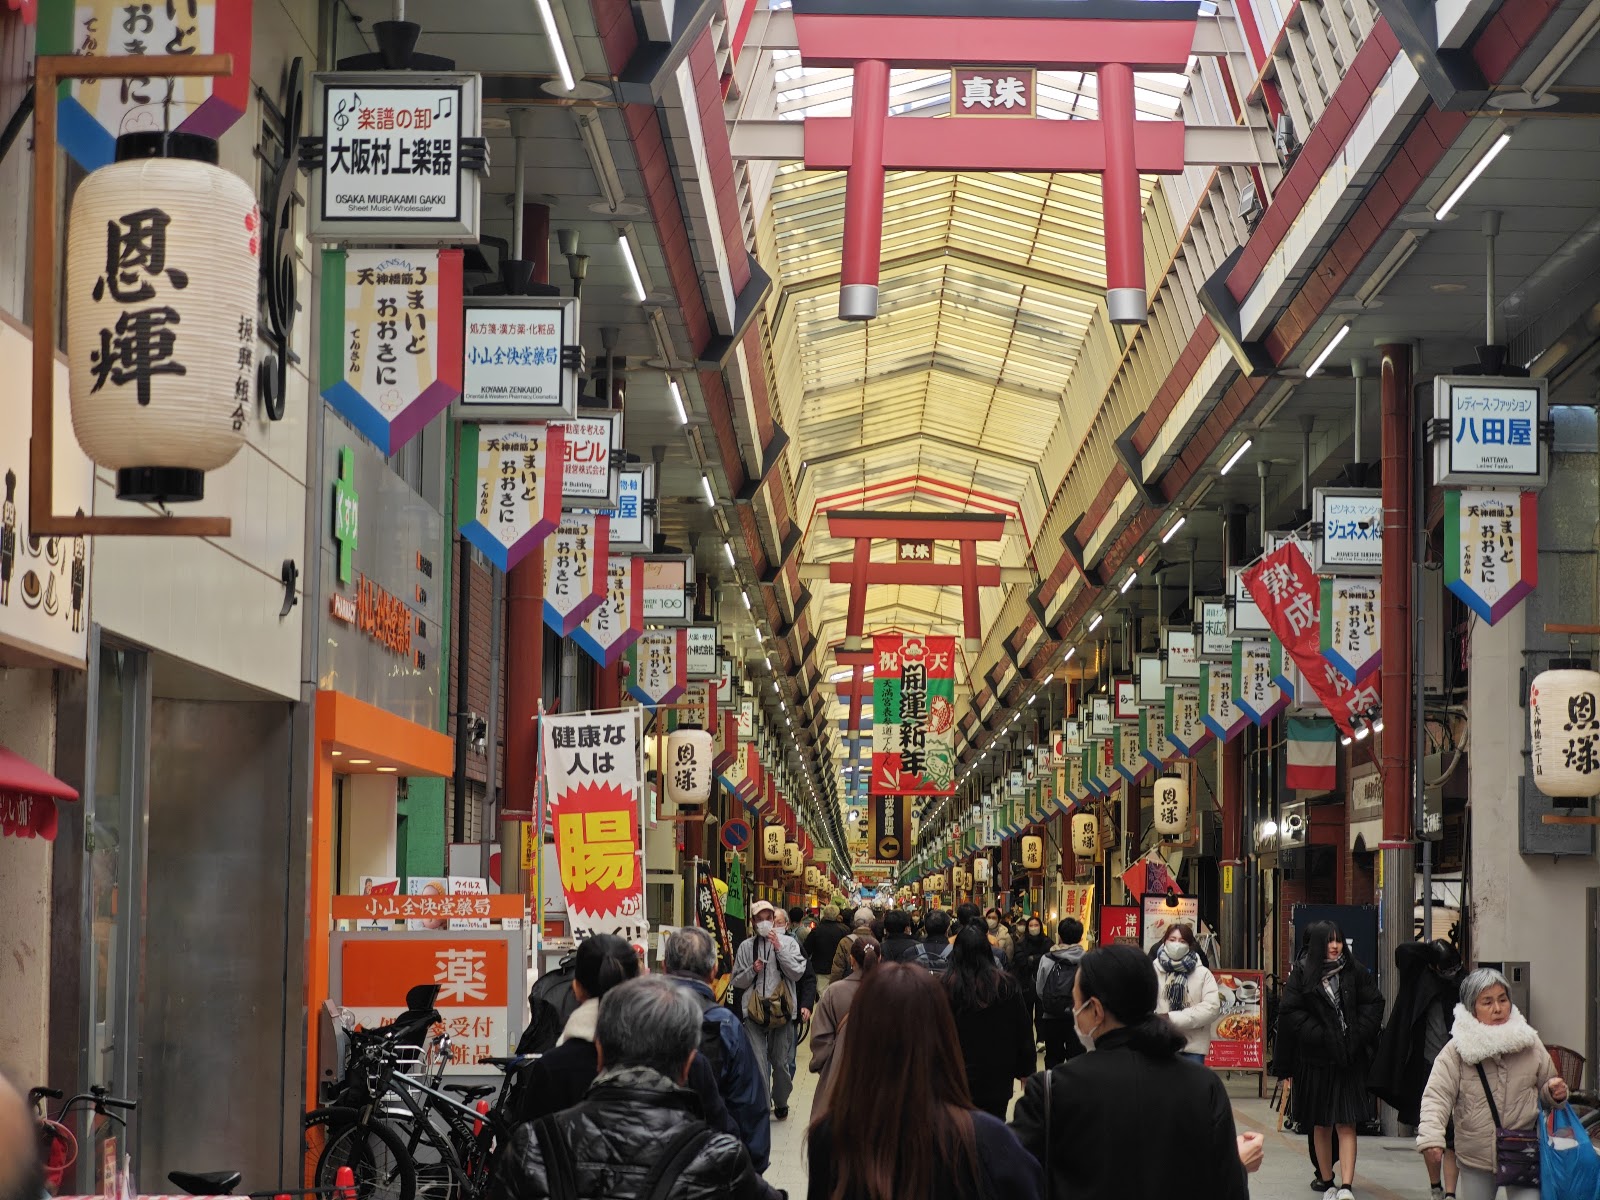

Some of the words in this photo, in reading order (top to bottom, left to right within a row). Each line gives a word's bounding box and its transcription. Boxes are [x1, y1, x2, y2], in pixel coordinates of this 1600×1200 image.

[961, 76, 1027, 109] 真朱
[357, 107, 432, 130] 楽譜の卸
[330, 137, 453, 176] 大阪村上楽器
[335, 194, 365, 204] OSAKA
[367, 194, 417, 205] MURAKAMI
[419, 195, 446, 205] GAKKI
[348, 204, 369, 212] Sheet
[371, 204, 392, 212] Music
[394, 204, 433, 213] Wholesaler
[376, 258, 415, 272] TENSAN
[376, 297, 398, 386] おおきに
[405, 290, 427, 355] まいど
[350, 328, 361, 373] てんさん
[230, 315, 254, 432] 振興組合
[481, 386, 507, 394] KOYAMA
[1457, 397, 1532, 412] レディース・ファッション
[1455, 417, 1532, 446] 八田屋
[499, 460, 516, 523] おおきに
[521, 455, 537, 501] まいど
[573, 538, 588, 577] まいど
[1481, 525, 1495, 583] おおきに
[1500, 521, 1513, 563] まいど
[555, 541, 570, 595] おおきに
[613, 579, 625, 614] まいど
[1258, 561, 1320, 637] 熟成
[1348, 604, 1360, 651] おおきに
[650, 649, 660, 687] おおきに
[879, 651, 899, 671] 祝
[929, 651, 949, 671] 天
[552, 724, 626, 749] 健康な
[899, 663, 928, 777] 開運新年
[567, 752, 615, 775] 人は
[558, 809, 635, 893] 腸
[454, 880, 481, 889] ウイルス
[620, 896, 640, 916] が
[1125, 913, 1138, 937] 洋服
[433, 948, 489, 1003] 薬
